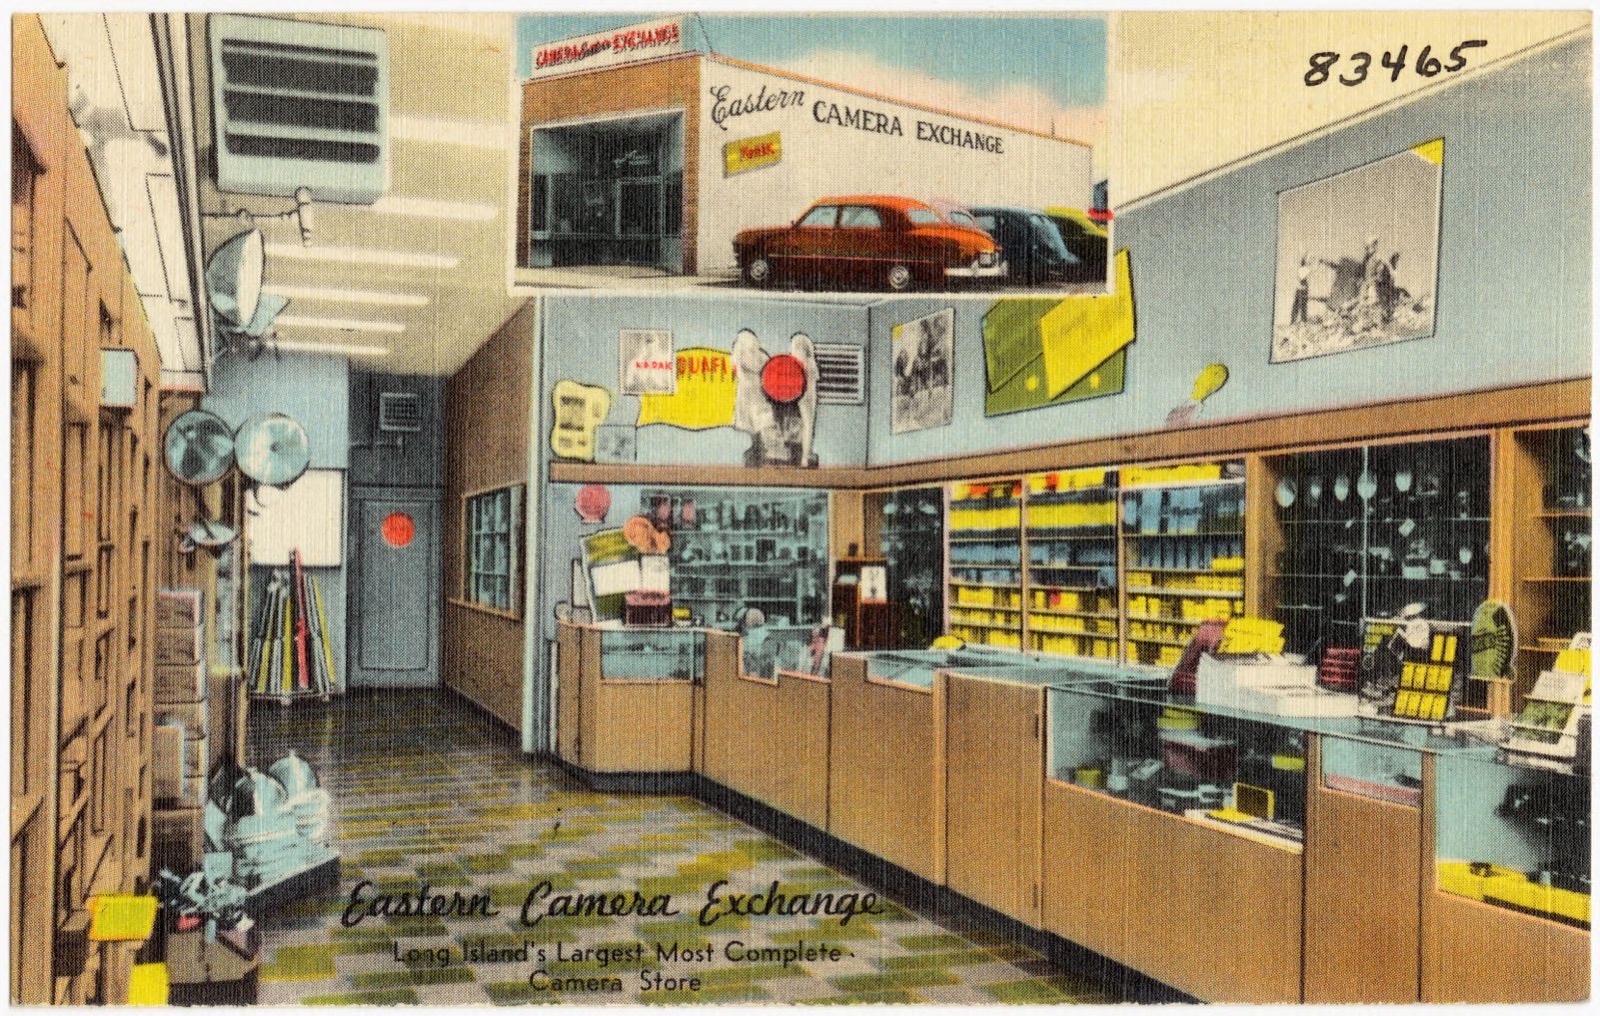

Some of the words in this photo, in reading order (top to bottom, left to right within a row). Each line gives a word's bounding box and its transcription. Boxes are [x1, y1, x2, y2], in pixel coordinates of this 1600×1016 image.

[612, 22, 681, 54] EXCHANGE
[1304, 39, 1488, 87] 83465
[709, 84, 805, 131] Eastern
[812, 100, 903, 137] CAMERA
[916, 120, 1005, 154] EXCHANGE
